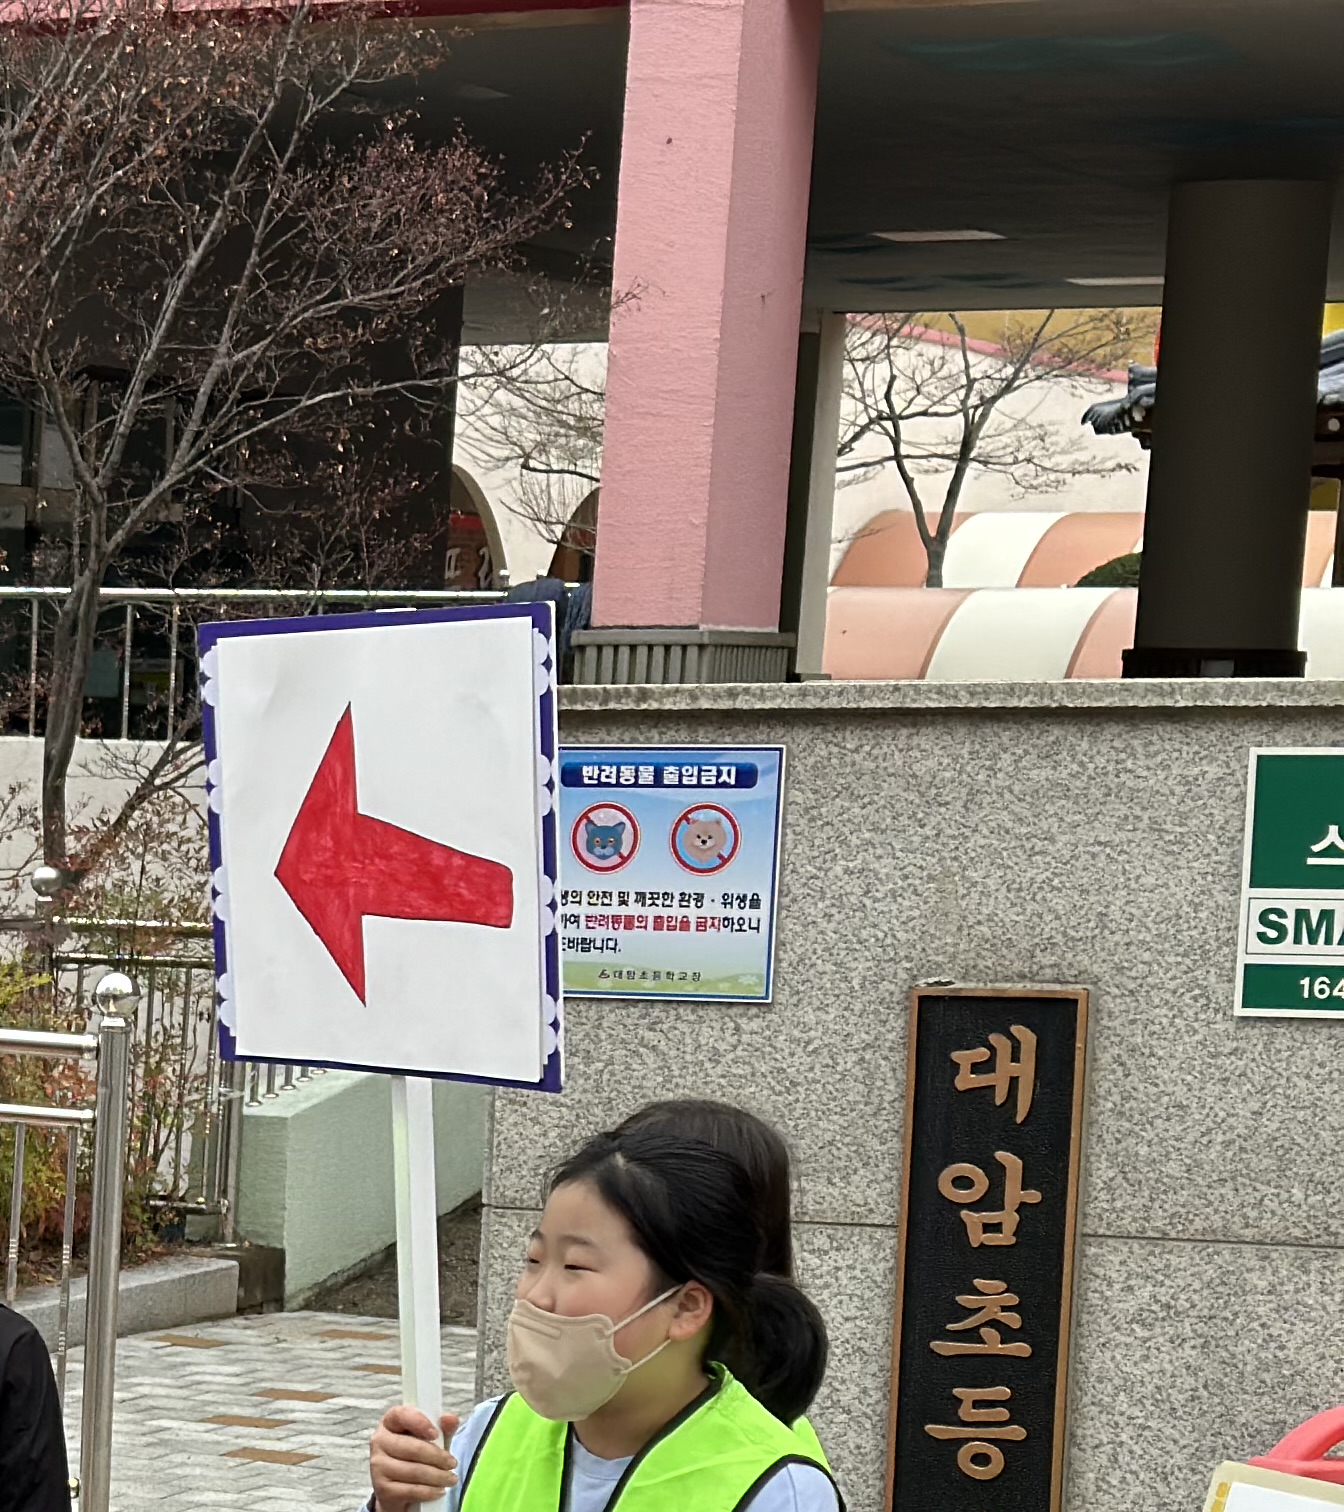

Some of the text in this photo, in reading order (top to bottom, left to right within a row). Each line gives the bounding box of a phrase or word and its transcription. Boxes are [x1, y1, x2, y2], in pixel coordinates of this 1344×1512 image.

[582, 765, 737, 785] 반려동물 출입금지
[587, 890, 613, 907] 안전
[618, 891, 630, 907] 및
[634, 891, 675, 908] 깨끗한
[678, 891, 705, 909] 환경
[720, 892, 762, 910] 위생을
[585, 913, 648, 931] 반려동물의
[695, 916, 761, 933] 금지하오니
[1256, 907, 1344, 946] SM
[562, 936, 621, 954] 바랍니다.
